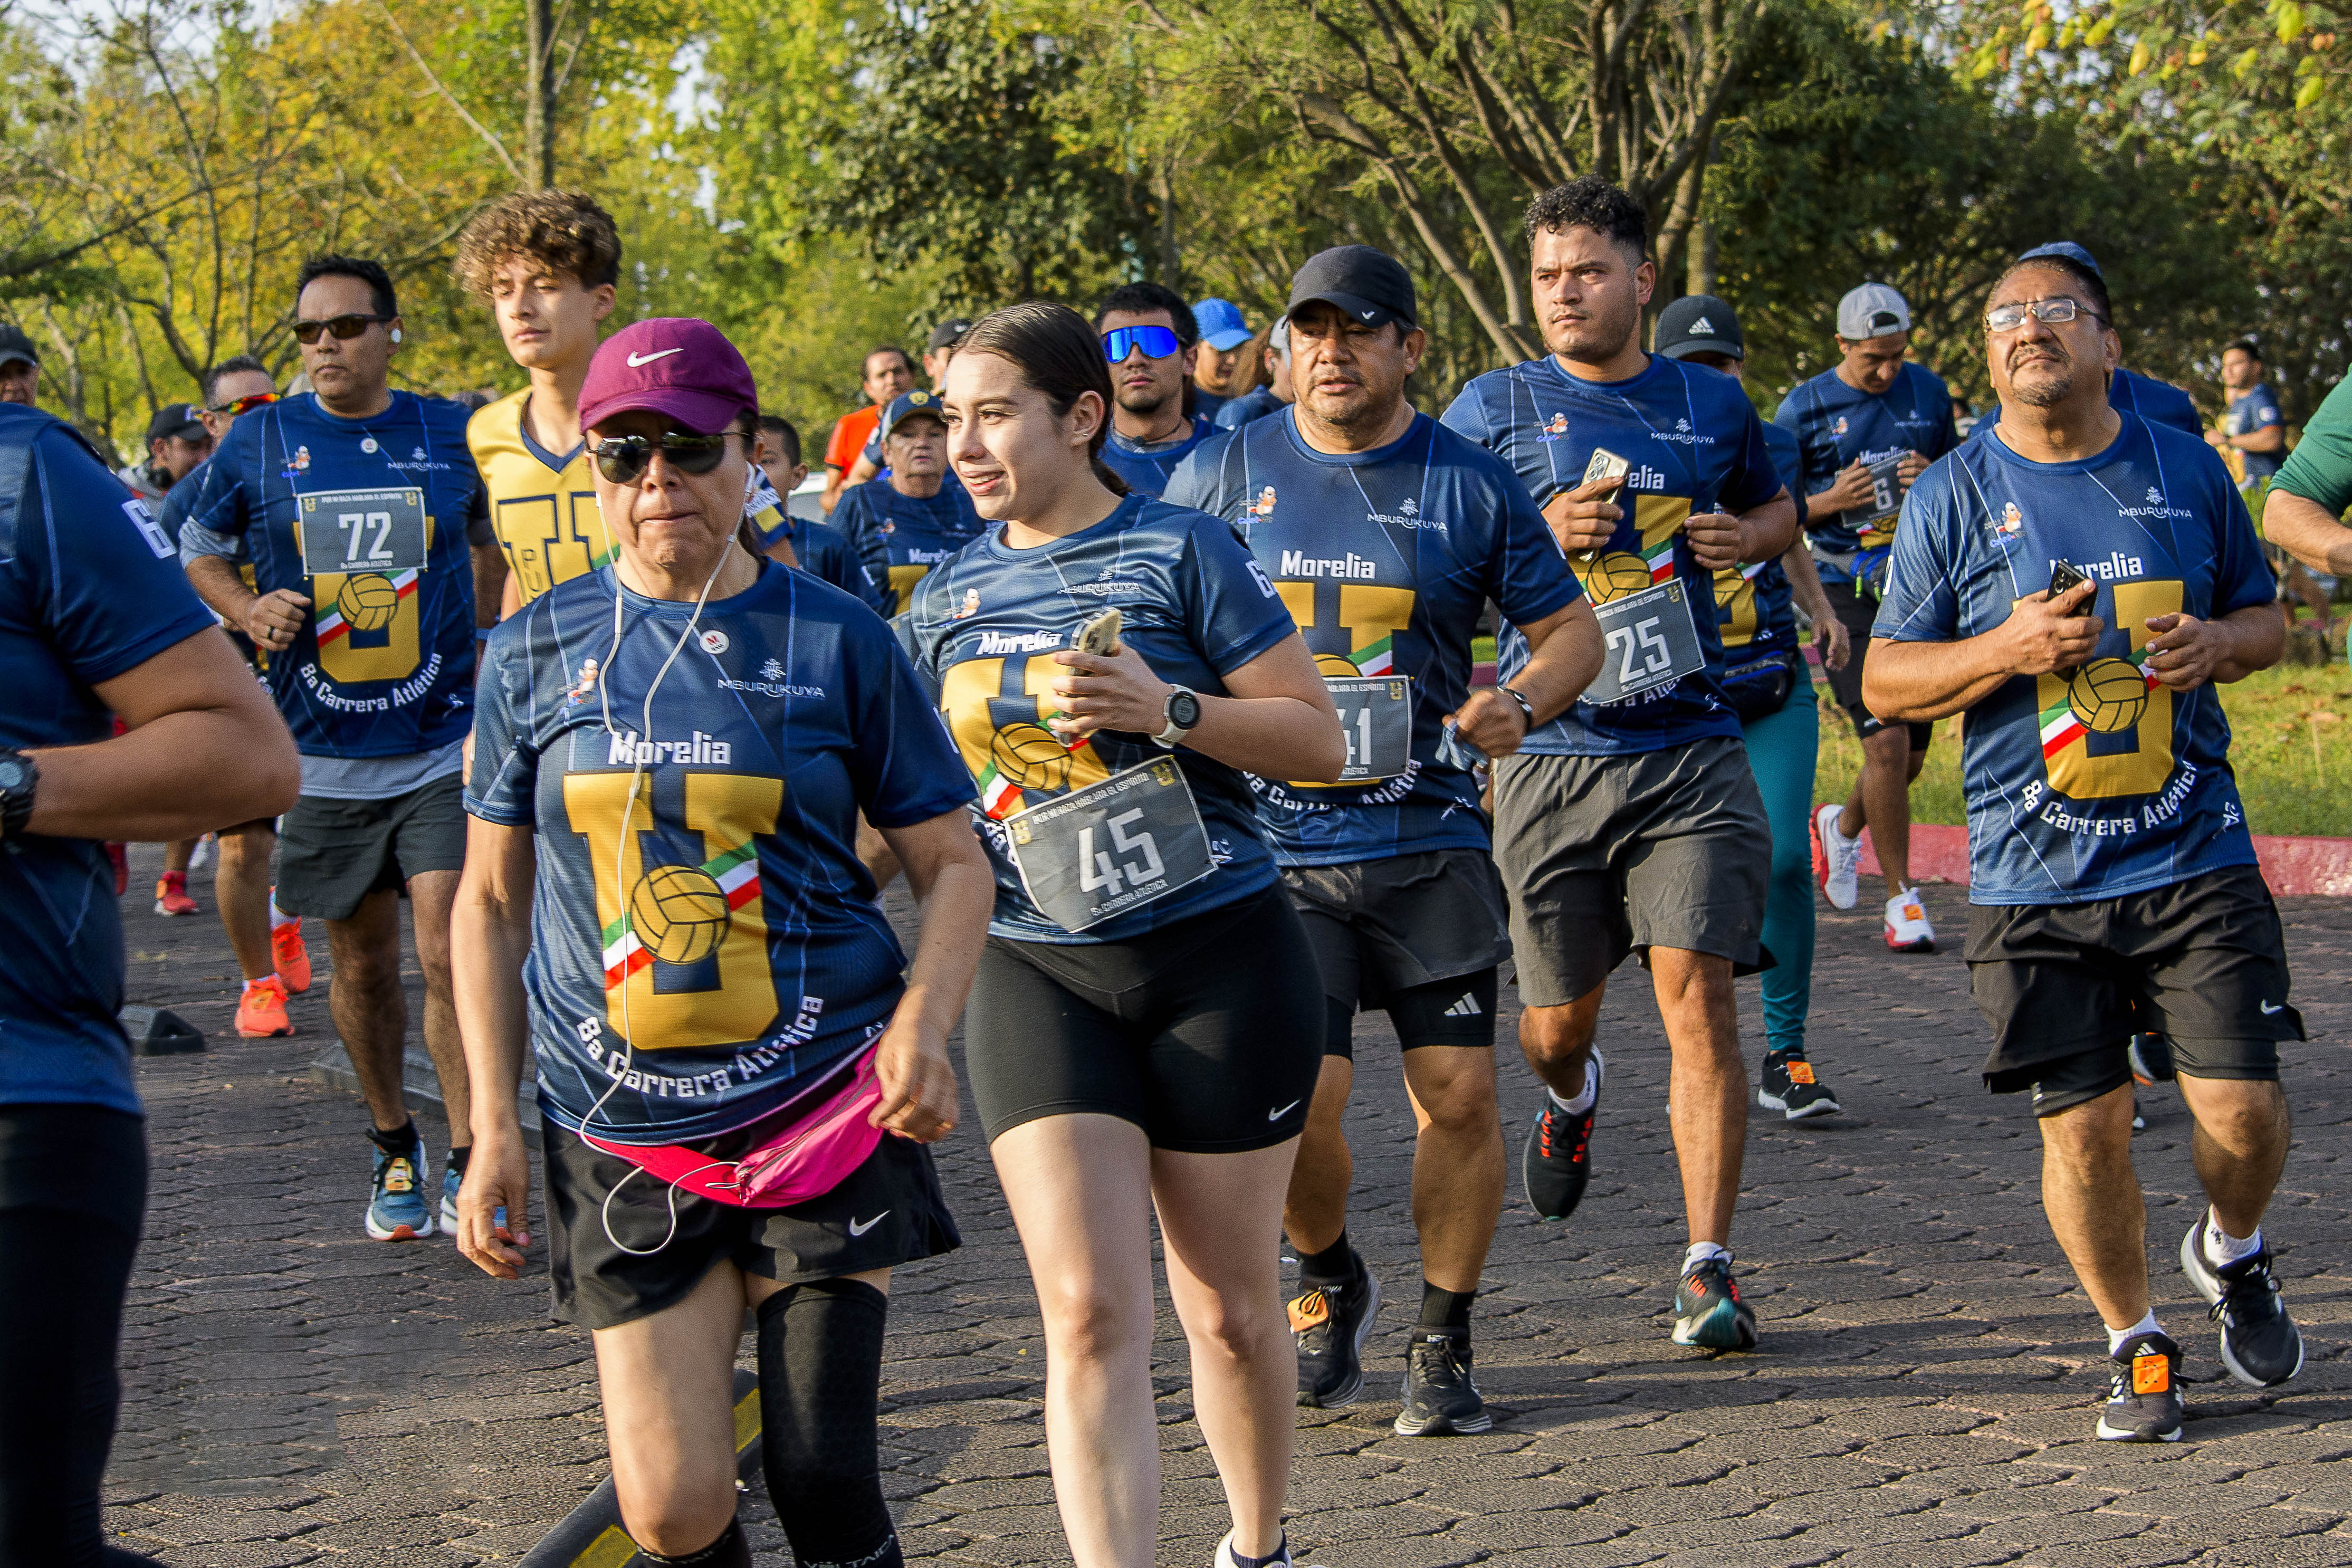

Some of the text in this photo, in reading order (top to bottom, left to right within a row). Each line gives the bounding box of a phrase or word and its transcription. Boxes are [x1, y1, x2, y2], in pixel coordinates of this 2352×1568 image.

[1651, 433, 1715, 444] MBURUKUYA
[1628, 465, 1665, 490] elia
[1367, 513, 1448, 531] MBURUKUYA
[2118, 506, 2193, 519] MBURUKUYA
[338, 512, 394, 561] 72
[1280, 550, 1376, 579] Morelia
[976, 630, 1064, 655] Morelia
[1605, 615, 1671, 684] 25
[316, 682, 388, 713] Carrera
[718, 678, 826, 699] MBURUKUYA
[608, 731, 731, 764] Morelia
[2040, 801, 2136, 836] Carrera
[1078, 807, 1165, 896] 45
[604, 1050, 733, 1098] Carrera
